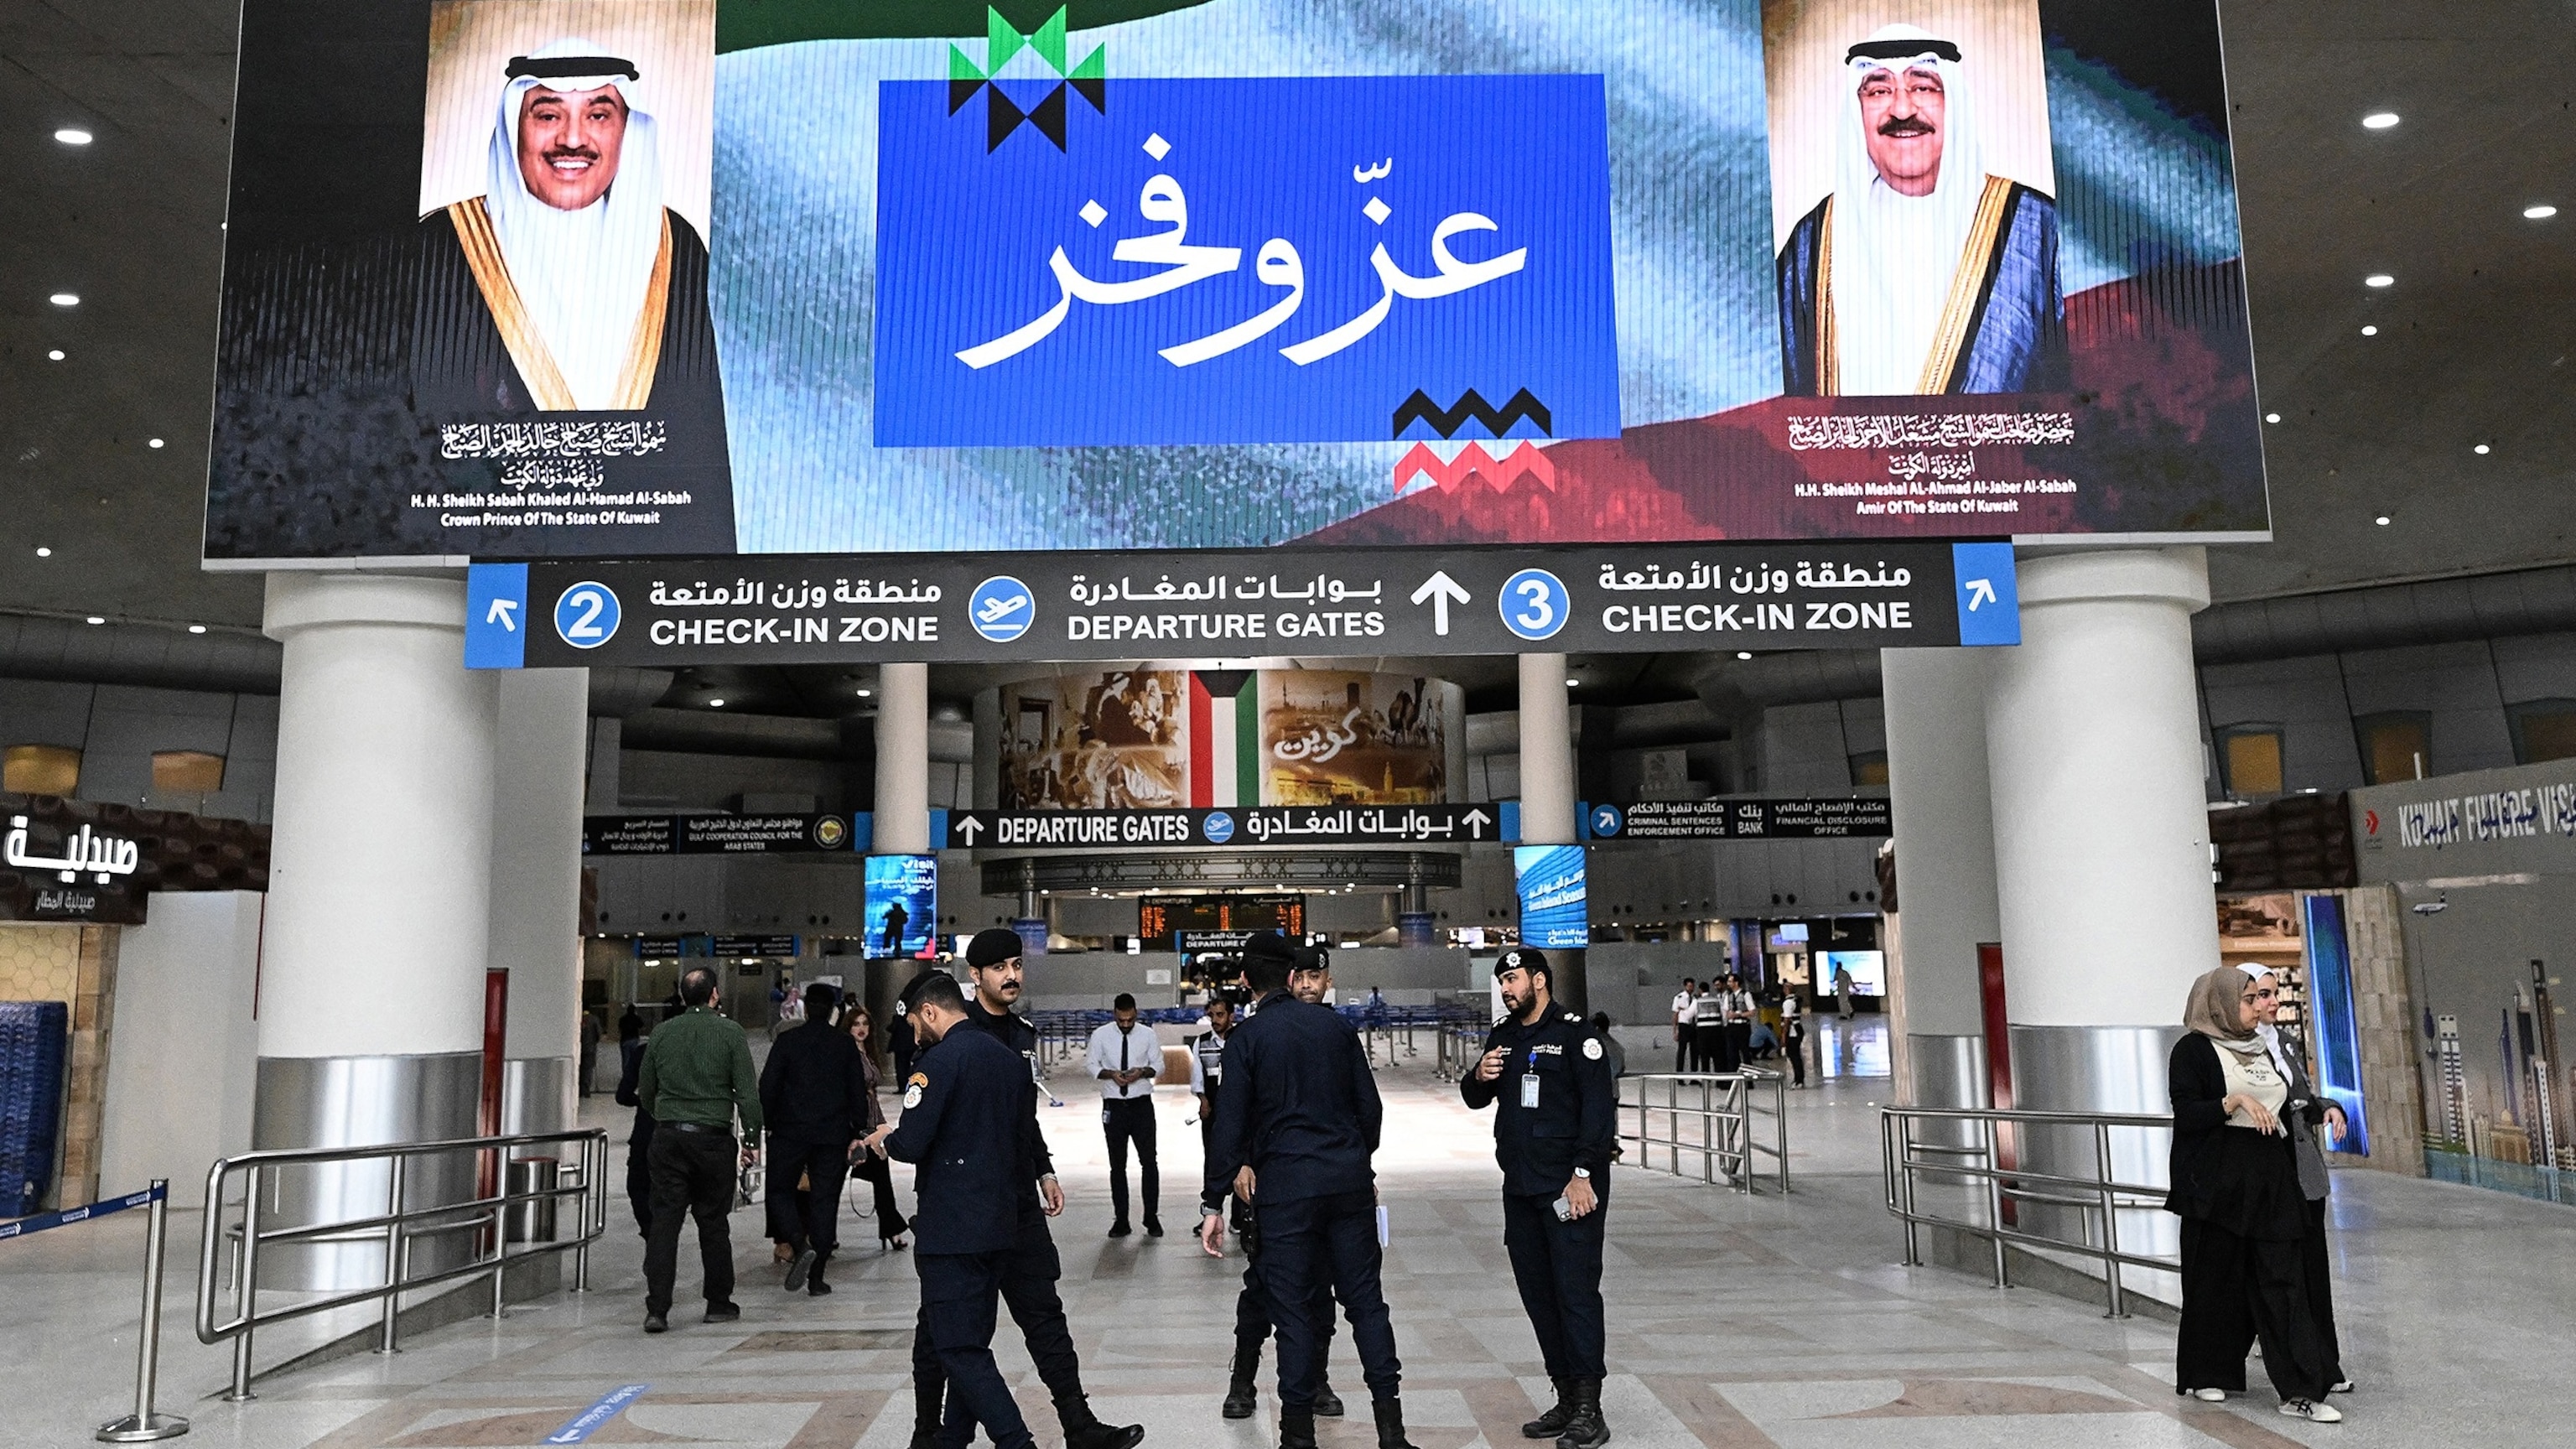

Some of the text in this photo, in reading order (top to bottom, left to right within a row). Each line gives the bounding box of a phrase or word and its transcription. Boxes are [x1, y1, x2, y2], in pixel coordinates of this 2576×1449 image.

[442, 493, 485, 507] Sheikh
[487, 492, 525, 506] Sabah
[527, 492, 571, 506] Khaled
[573, 491, 633, 506] Al-Hamad
[636, 491, 691, 504] Al-Sabah
[1822, 483, 1863, 496] Sheikh
[1865, 482, 1907, 496] Meshal
[1973, 480, 2022, 494] Al-Jaber
[2023, 479, 2077, 493] Al-Sabah
[440, 511, 660, 527] Crown Prince Of The State Of Kuwait
[1857, 499, 2018, 514] Amir Of The State Of Kuwait
[1069, 574, 1382, 605] بوابات المغادرة
[1599, 562, 1911, 595] منطقة وزن الأمتعة
[649, 578, 941, 610] منطقة وزن الأمتعة
[1516, 580, 1554, 629] 3
[568, 591, 603, 637] 2
[1067, 612, 1384, 641] DEPARTURE GATES
[1602, 603, 1912, 632] CHECK-IN ZONE
[650, 616, 938, 646] CHECK-IN ZONE
[1247, 810, 1453, 841] بوابات المغادرة
[1670, 817, 1722, 825] SENTENCES
[1738, 804, 1763, 820] بنك
[1776, 816, 1887, 825] FINANCIAL DISCLOSURE
[2398, 798, 2459, 848] KUWAIT
[2464, 788, 2536, 842] FUTURE
[998, 814, 1189, 843] DEPARTURE GATES
[1628, 827, 1725, 835] ENFORCEMENT OFFICE
[1737, 821, 1763, 834] BANK
[7, 815, 138, 885] صيدلية
